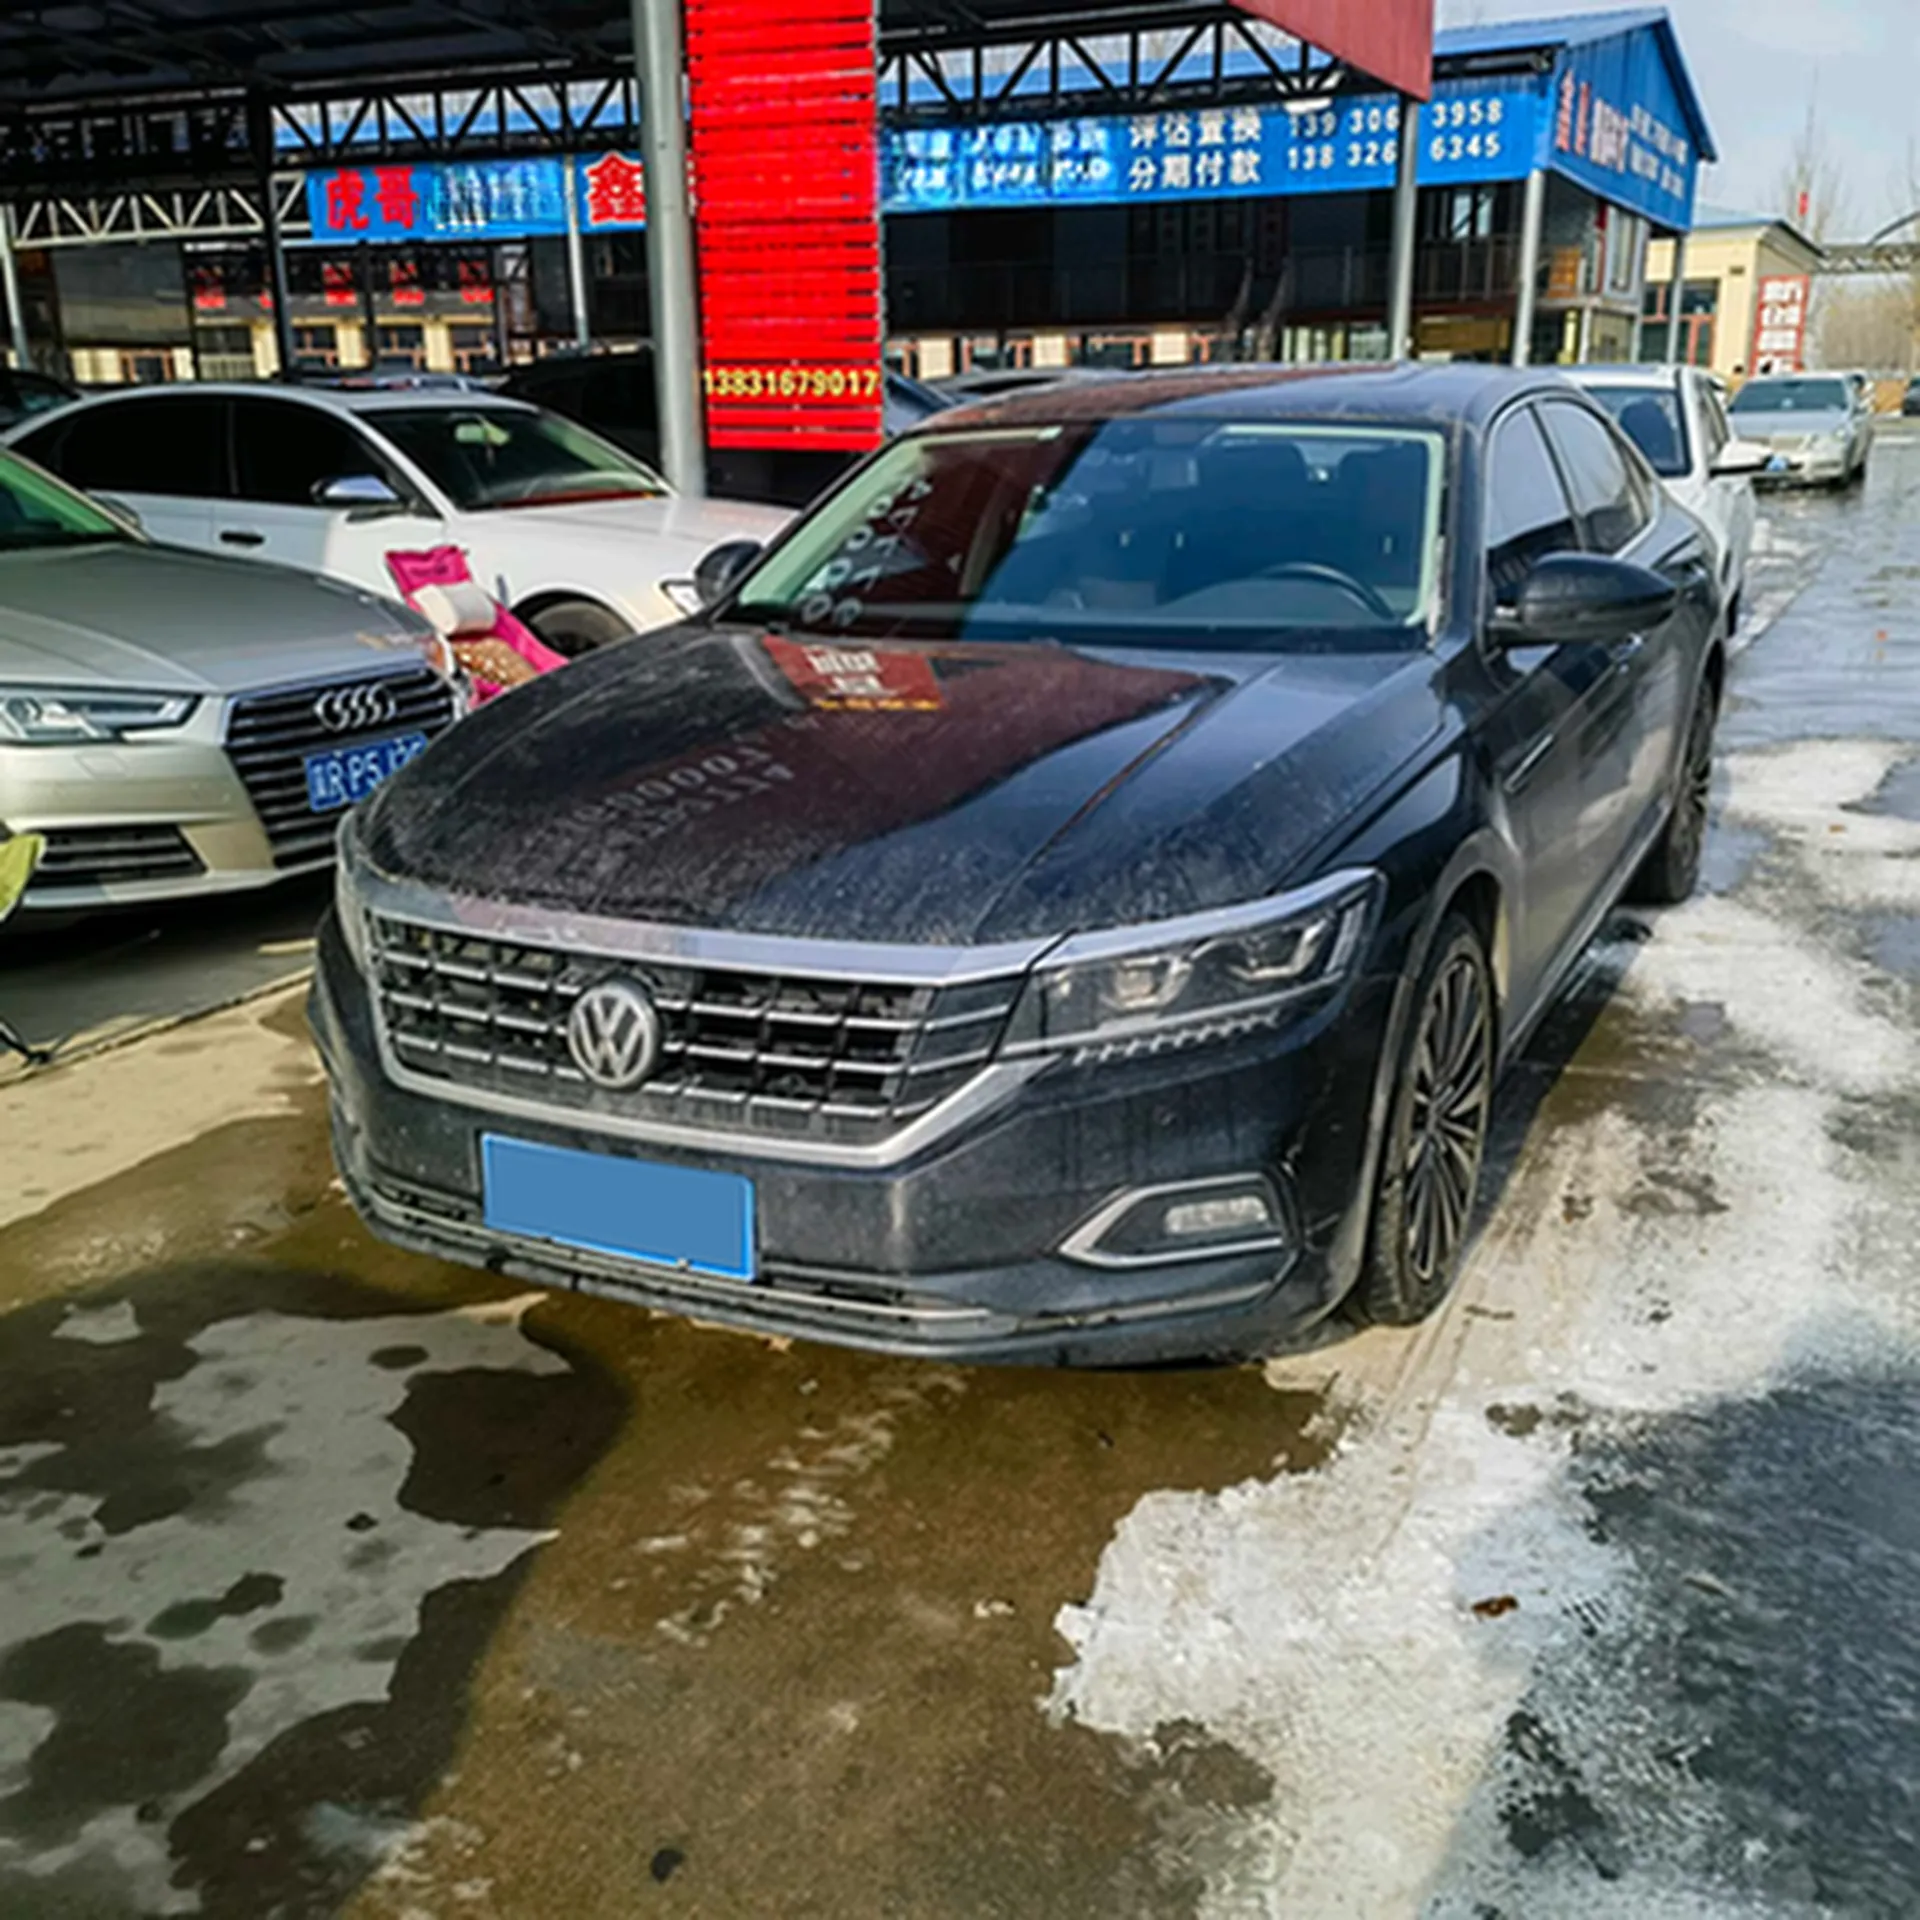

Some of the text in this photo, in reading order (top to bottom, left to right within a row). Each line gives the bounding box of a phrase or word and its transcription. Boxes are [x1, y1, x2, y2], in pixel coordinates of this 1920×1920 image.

[1349, 105, 1400, 135] 306
[1431, 98, 1503, 129] 3958
[1129, 149, 1262, 192] 分期付款
[1288, 131, 1502, 171] 138 326 6345
[326, 166, 419, 230] 虎哥
[584, 151, 647, 226] 鑫
[703, 368, 879, 397] 13831679017
